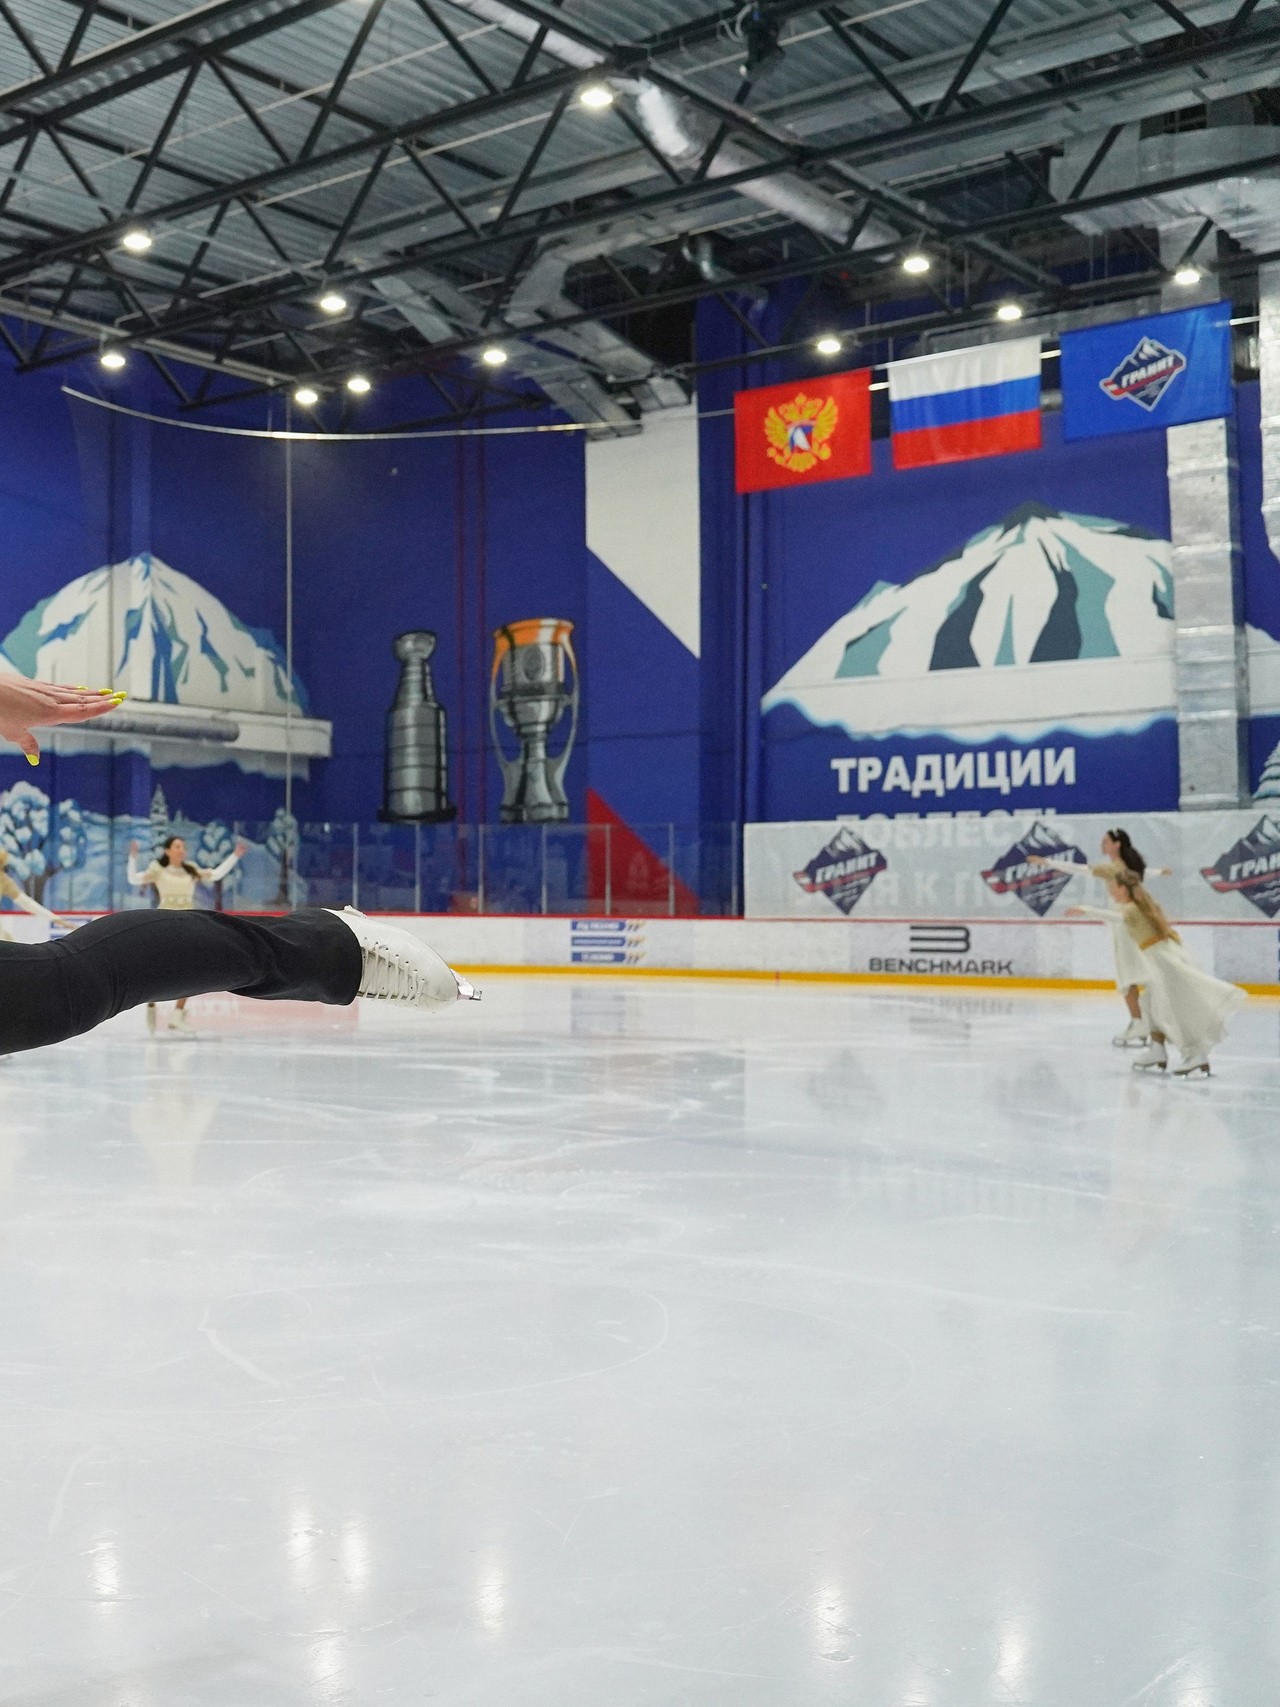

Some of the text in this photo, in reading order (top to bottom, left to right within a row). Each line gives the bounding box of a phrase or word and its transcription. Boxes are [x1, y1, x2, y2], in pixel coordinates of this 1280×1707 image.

[1121, 354, 1175, 388] ГРАНИТ
[830, 747, 1076, 798] ТРАДИЦИИ
[815, 851, 878, 884] ГРАНИТ
[1004, 848, 1074, 884] ГРАТ
[869, 957, 1014, 975] BENCHMARK
